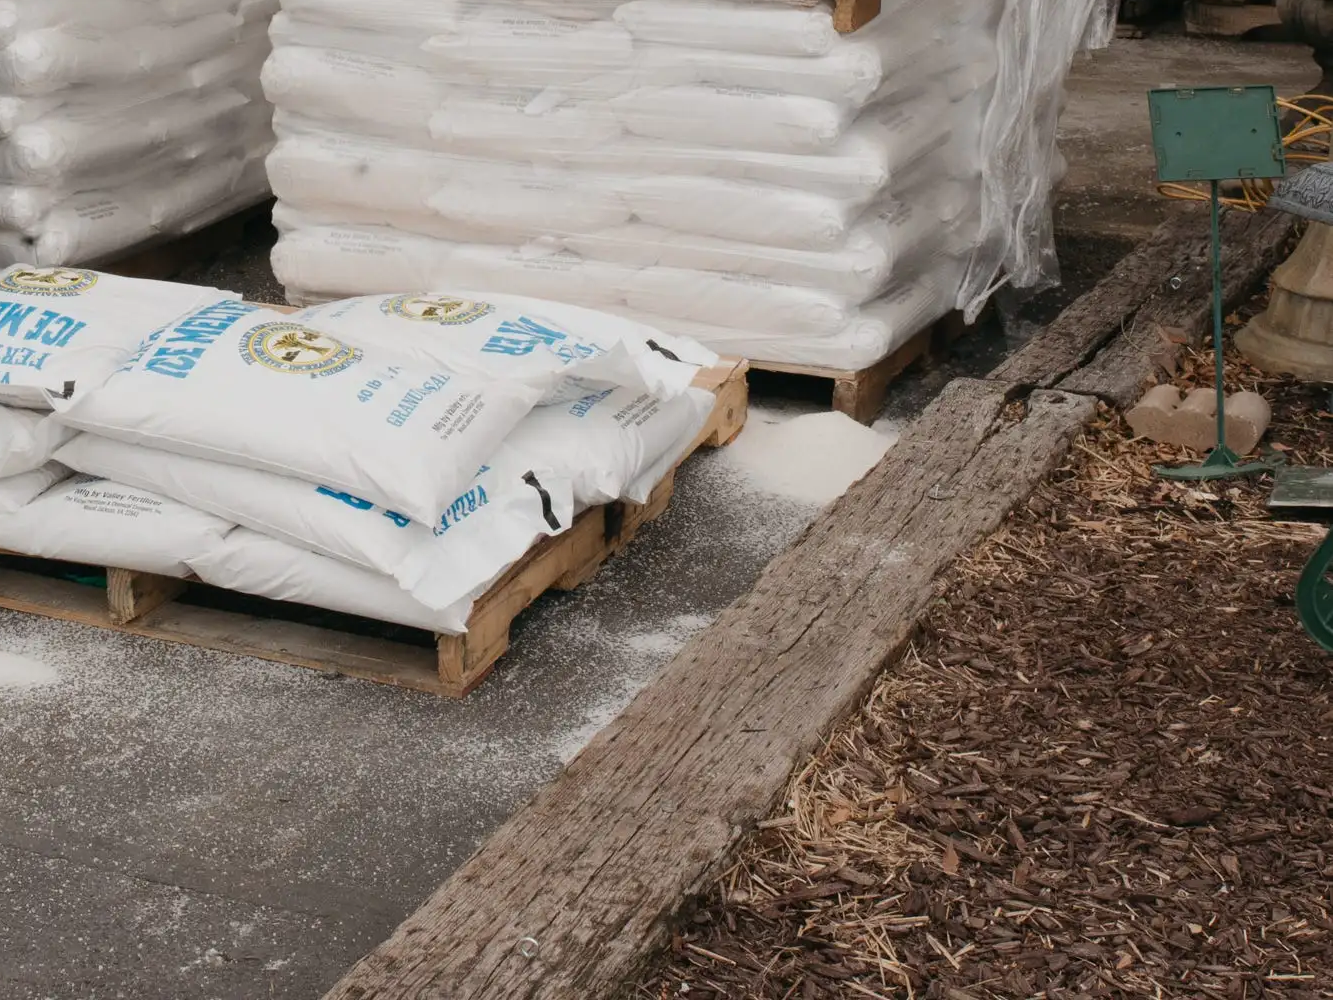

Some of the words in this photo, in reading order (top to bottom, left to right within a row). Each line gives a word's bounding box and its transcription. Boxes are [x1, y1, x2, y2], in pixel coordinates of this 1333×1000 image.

[24, 310, 87, 347] ICE
[143, 347, 206, 379] ICE
[423, 374, 451, 393] SAL
[357, 389, 374, 403] 40
[74, 488, 90, 497] Mfg
[103, 491, 126, 500] Valley
[127, 494, 163, 506] Fertilizer
